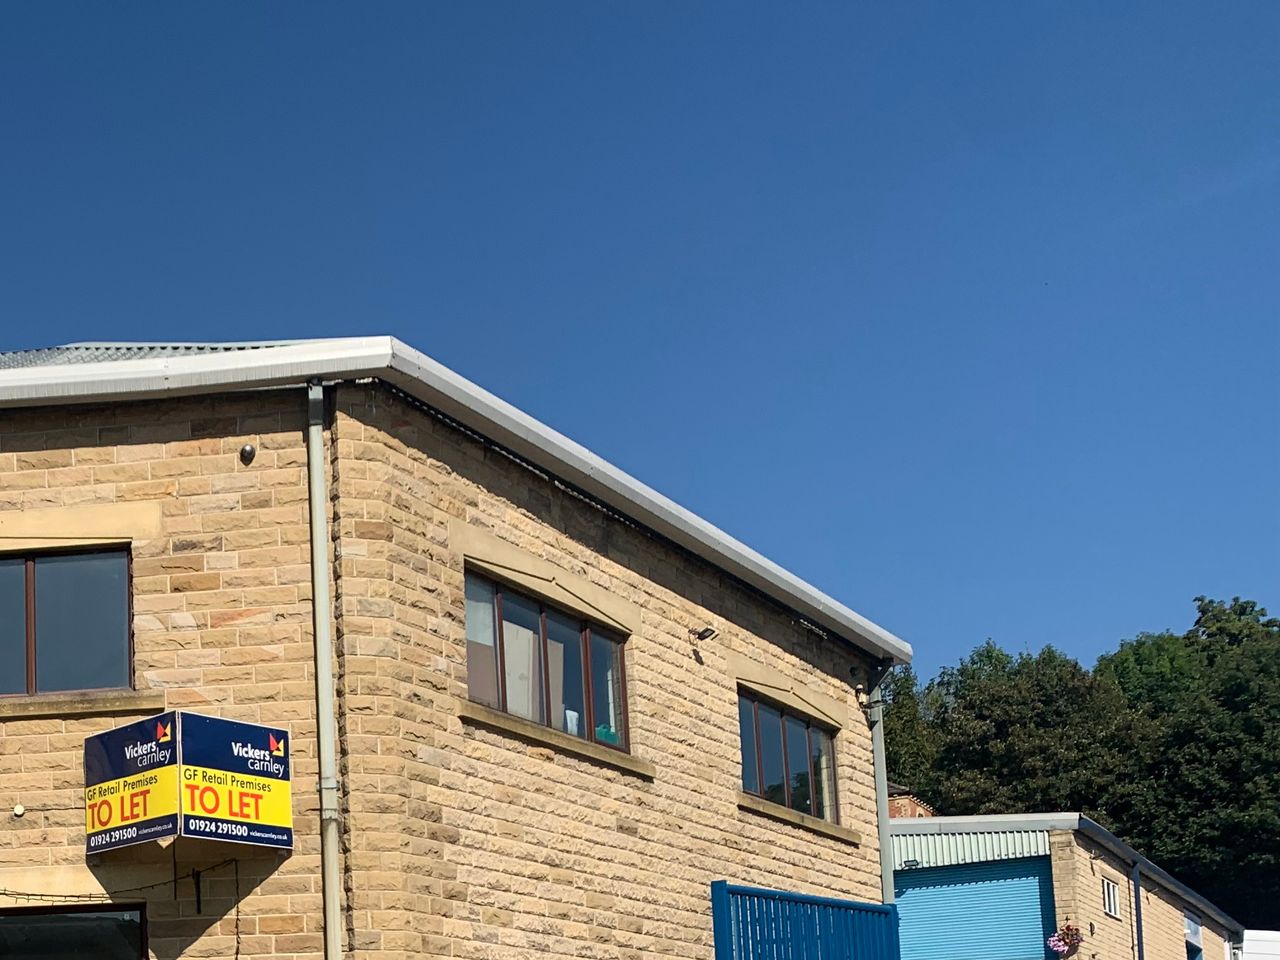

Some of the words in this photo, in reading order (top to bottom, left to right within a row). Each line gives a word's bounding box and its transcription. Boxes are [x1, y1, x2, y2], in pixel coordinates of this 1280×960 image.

[125, 741, 157, 760] Vickers
[137, 747, 172, 767] carnley
[231, 741, 271, 761] Vickers
[248, 758, 285, 777] carnley
[86, 788, 97, 801] GF
[98, 781, 120, 798] Retail
[123, 774, 158, 792] Premises
[183, 768, 199, 781] GF
[202, 770, 228, 786] Retail
[231, 775, 272, 793] Premises
[87, 799, 113, 829] TO
[120, 789, 151, 822] LET
[185, 783, 220, 814] TO
[228, 789, 263, 820] LET
[90, 832, 110, 847] 01924
[111, 826, 137, 842] 291500
[189, 818, 216, 833] 01924
[217, 822, 248, 836] 291500
